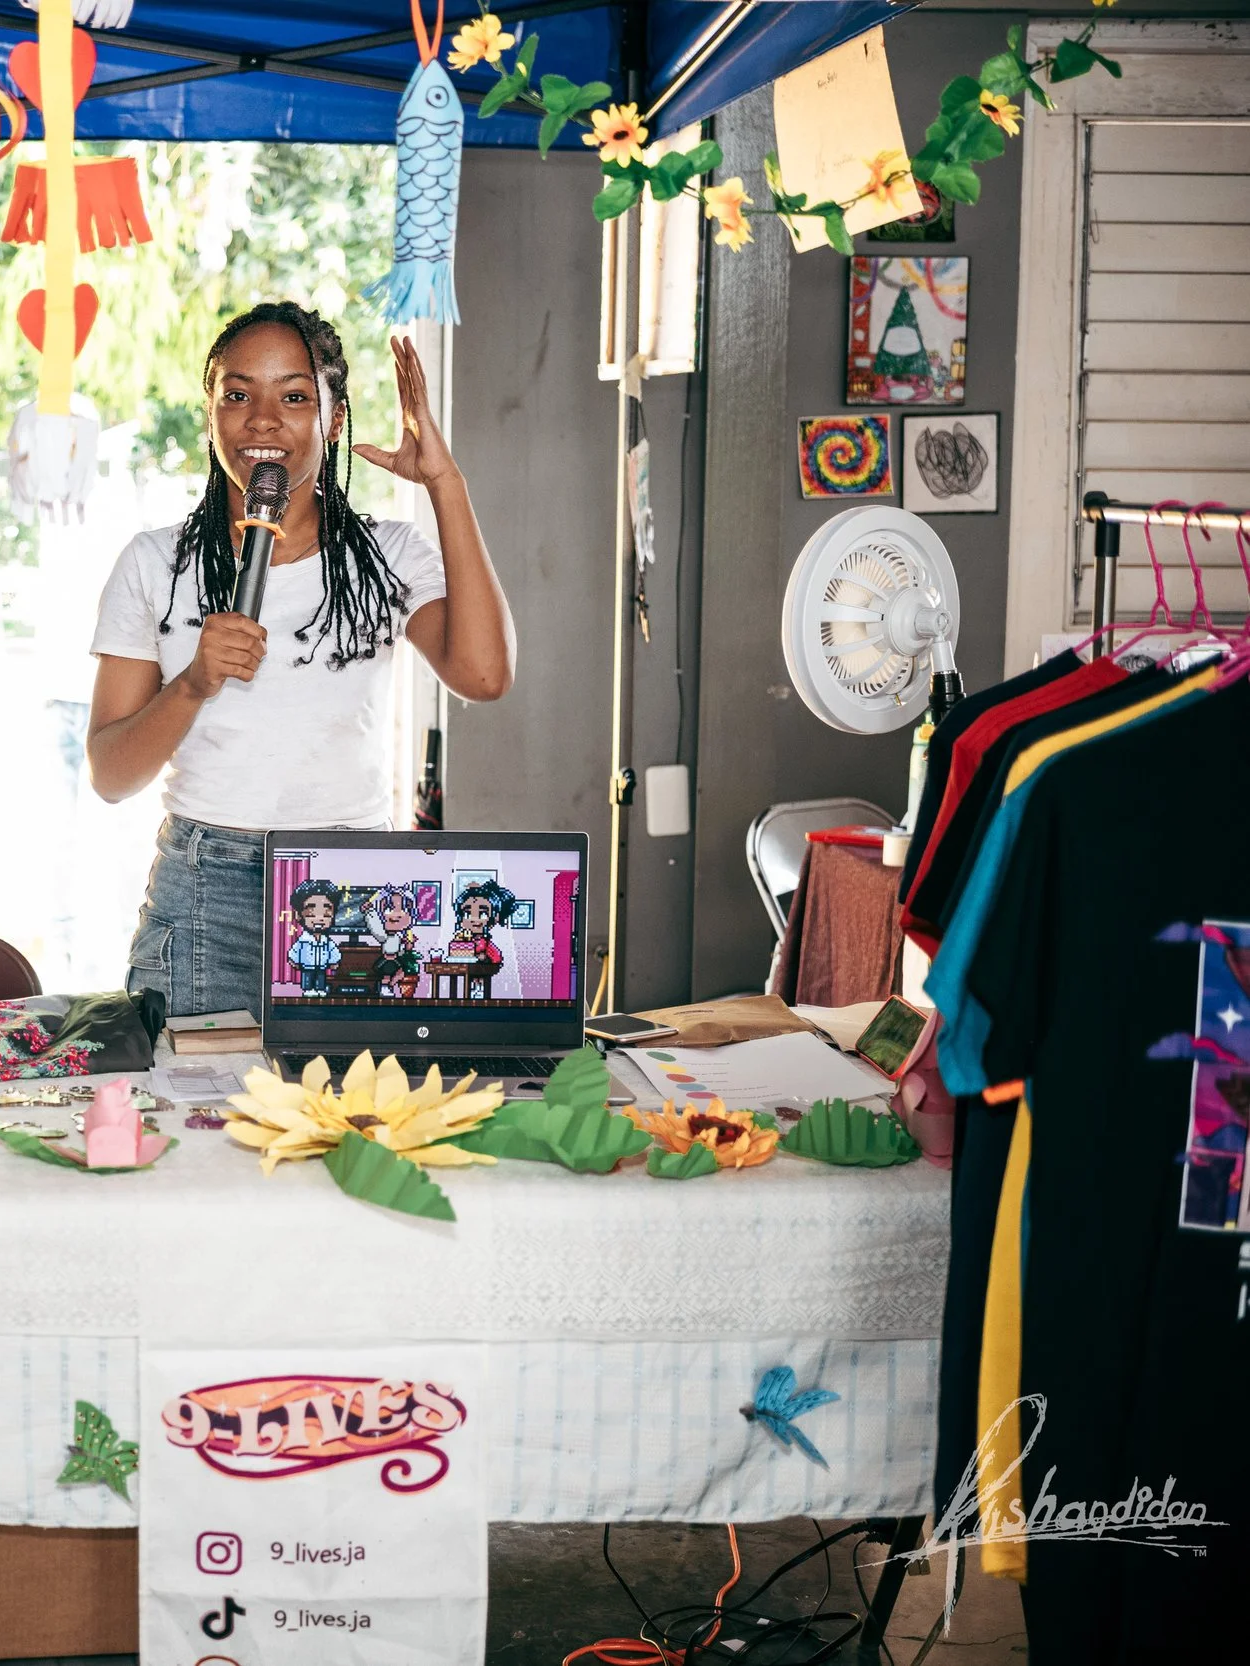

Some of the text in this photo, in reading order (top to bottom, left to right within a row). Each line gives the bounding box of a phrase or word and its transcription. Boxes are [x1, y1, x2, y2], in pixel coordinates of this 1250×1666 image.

[417, 1026, 429, 1038] hp
[162, 1378, 462, 1457] 9-LIVES
[270, 1542, 366, 1566] 9_lives.ja
[274, 1610, 372, 1632] 9_lives.ja
